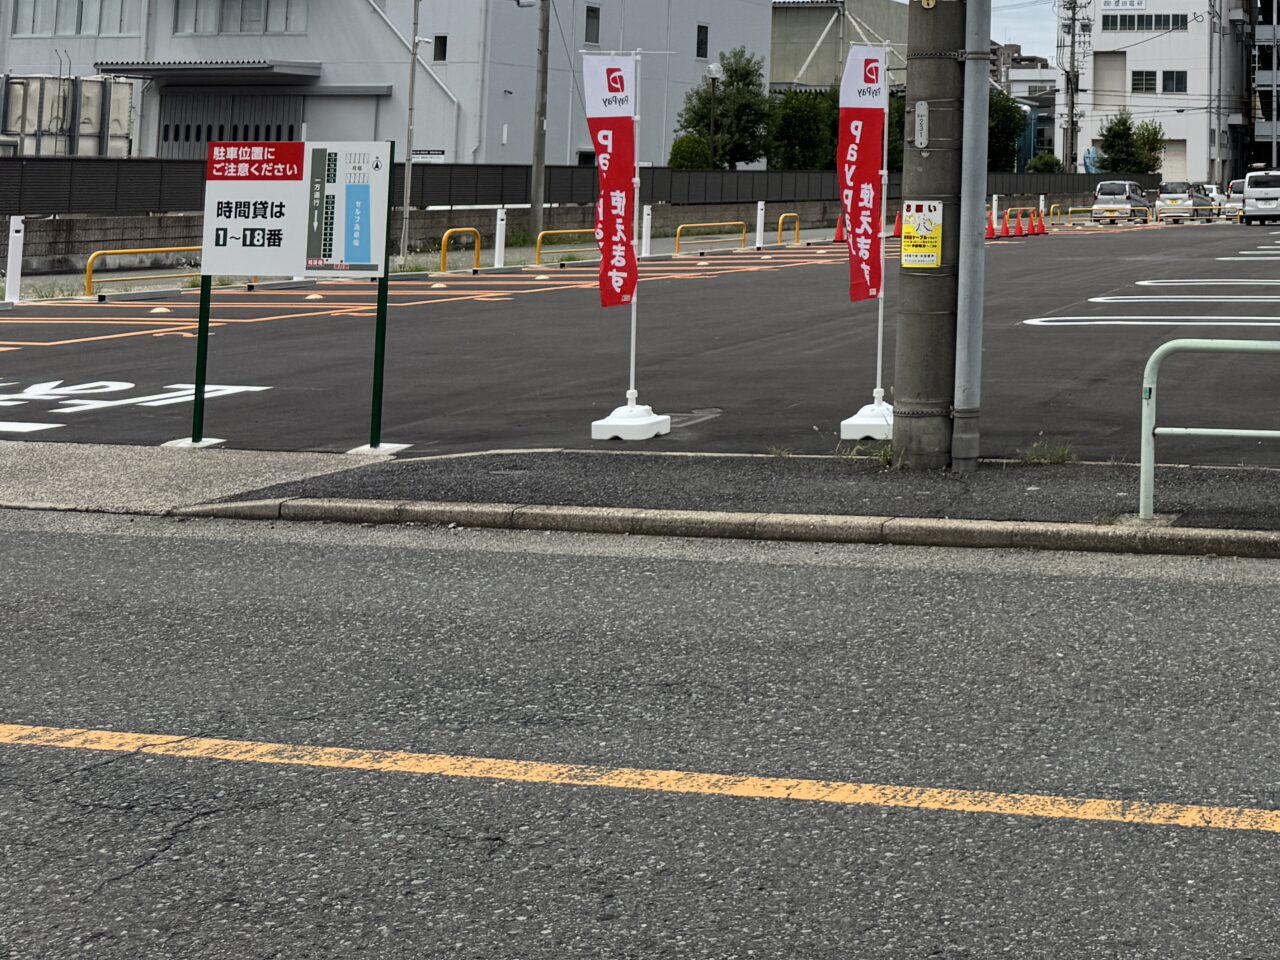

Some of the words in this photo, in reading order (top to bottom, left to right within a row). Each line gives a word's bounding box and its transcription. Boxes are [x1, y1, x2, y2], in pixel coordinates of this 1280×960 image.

[213, 146, 276, 161] 駐車位置に
[212, 163, 298, 177] ご注意ください
[216, 200, 286, 220] 時間貸は
